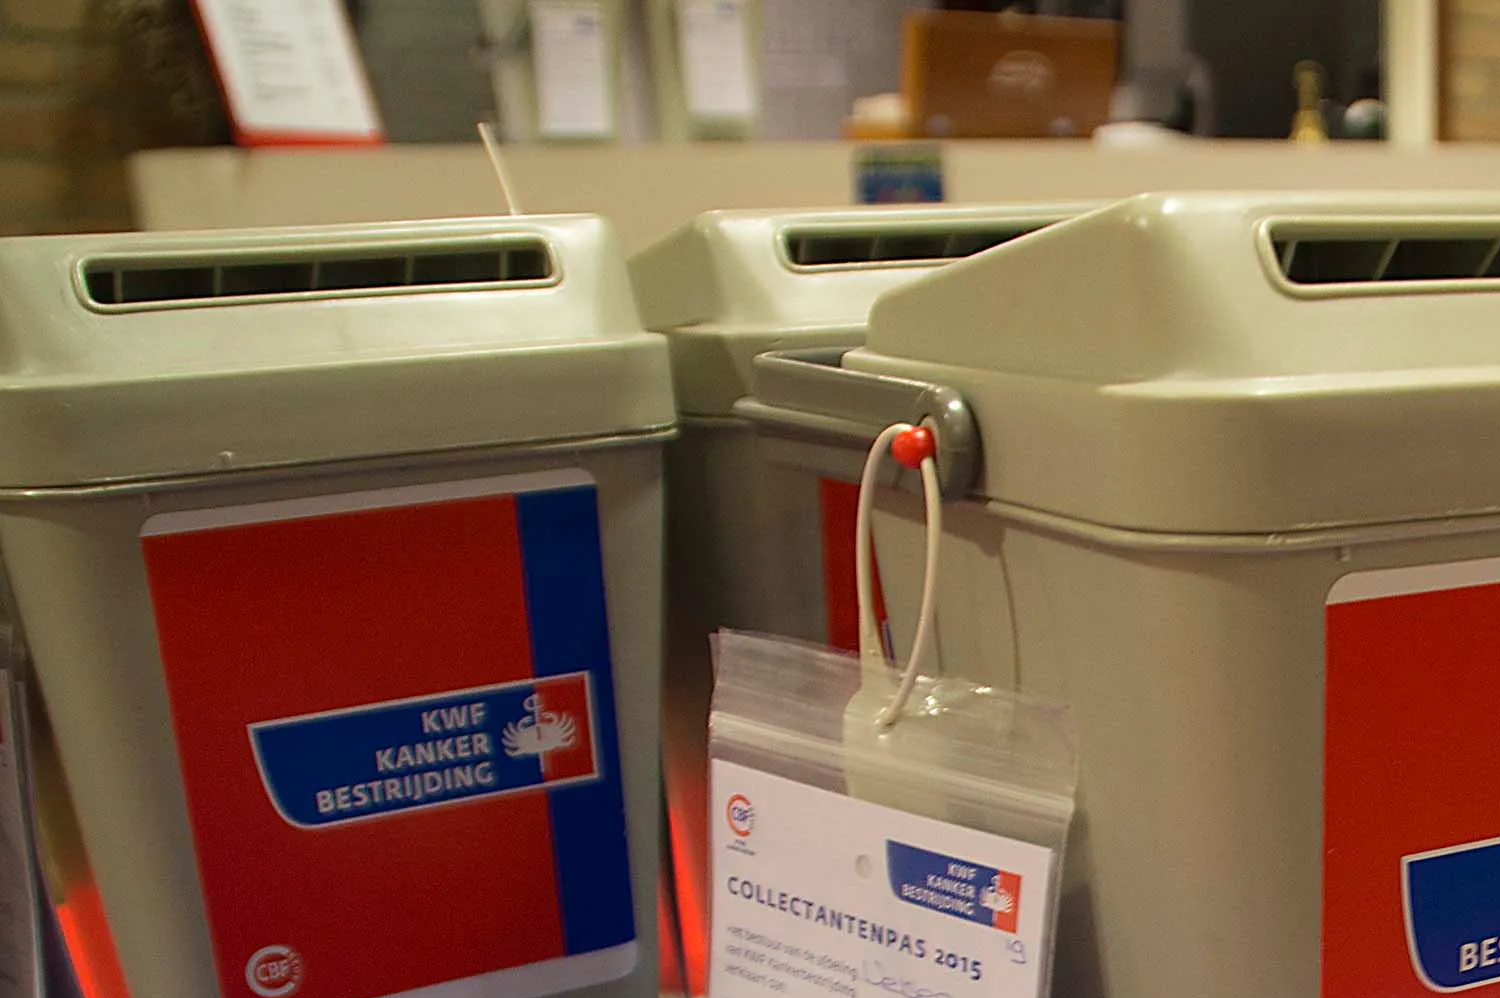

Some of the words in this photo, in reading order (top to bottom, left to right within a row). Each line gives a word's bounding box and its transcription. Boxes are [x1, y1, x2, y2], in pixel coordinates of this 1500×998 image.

[421, 703, 487, 734] KWF
[376, 732, 491, 773] KANKER
[316, 762, 494, 813] BESTRIJDING
[927, 873, 976, 899] KANKER
[947, 862, 977, 880] KWF
[901, 883, 975, 915] BESTRIJDING
[727, 875, 926, 959] COLLECTANTENPAS
[934, 948, 983, 981] 2015
